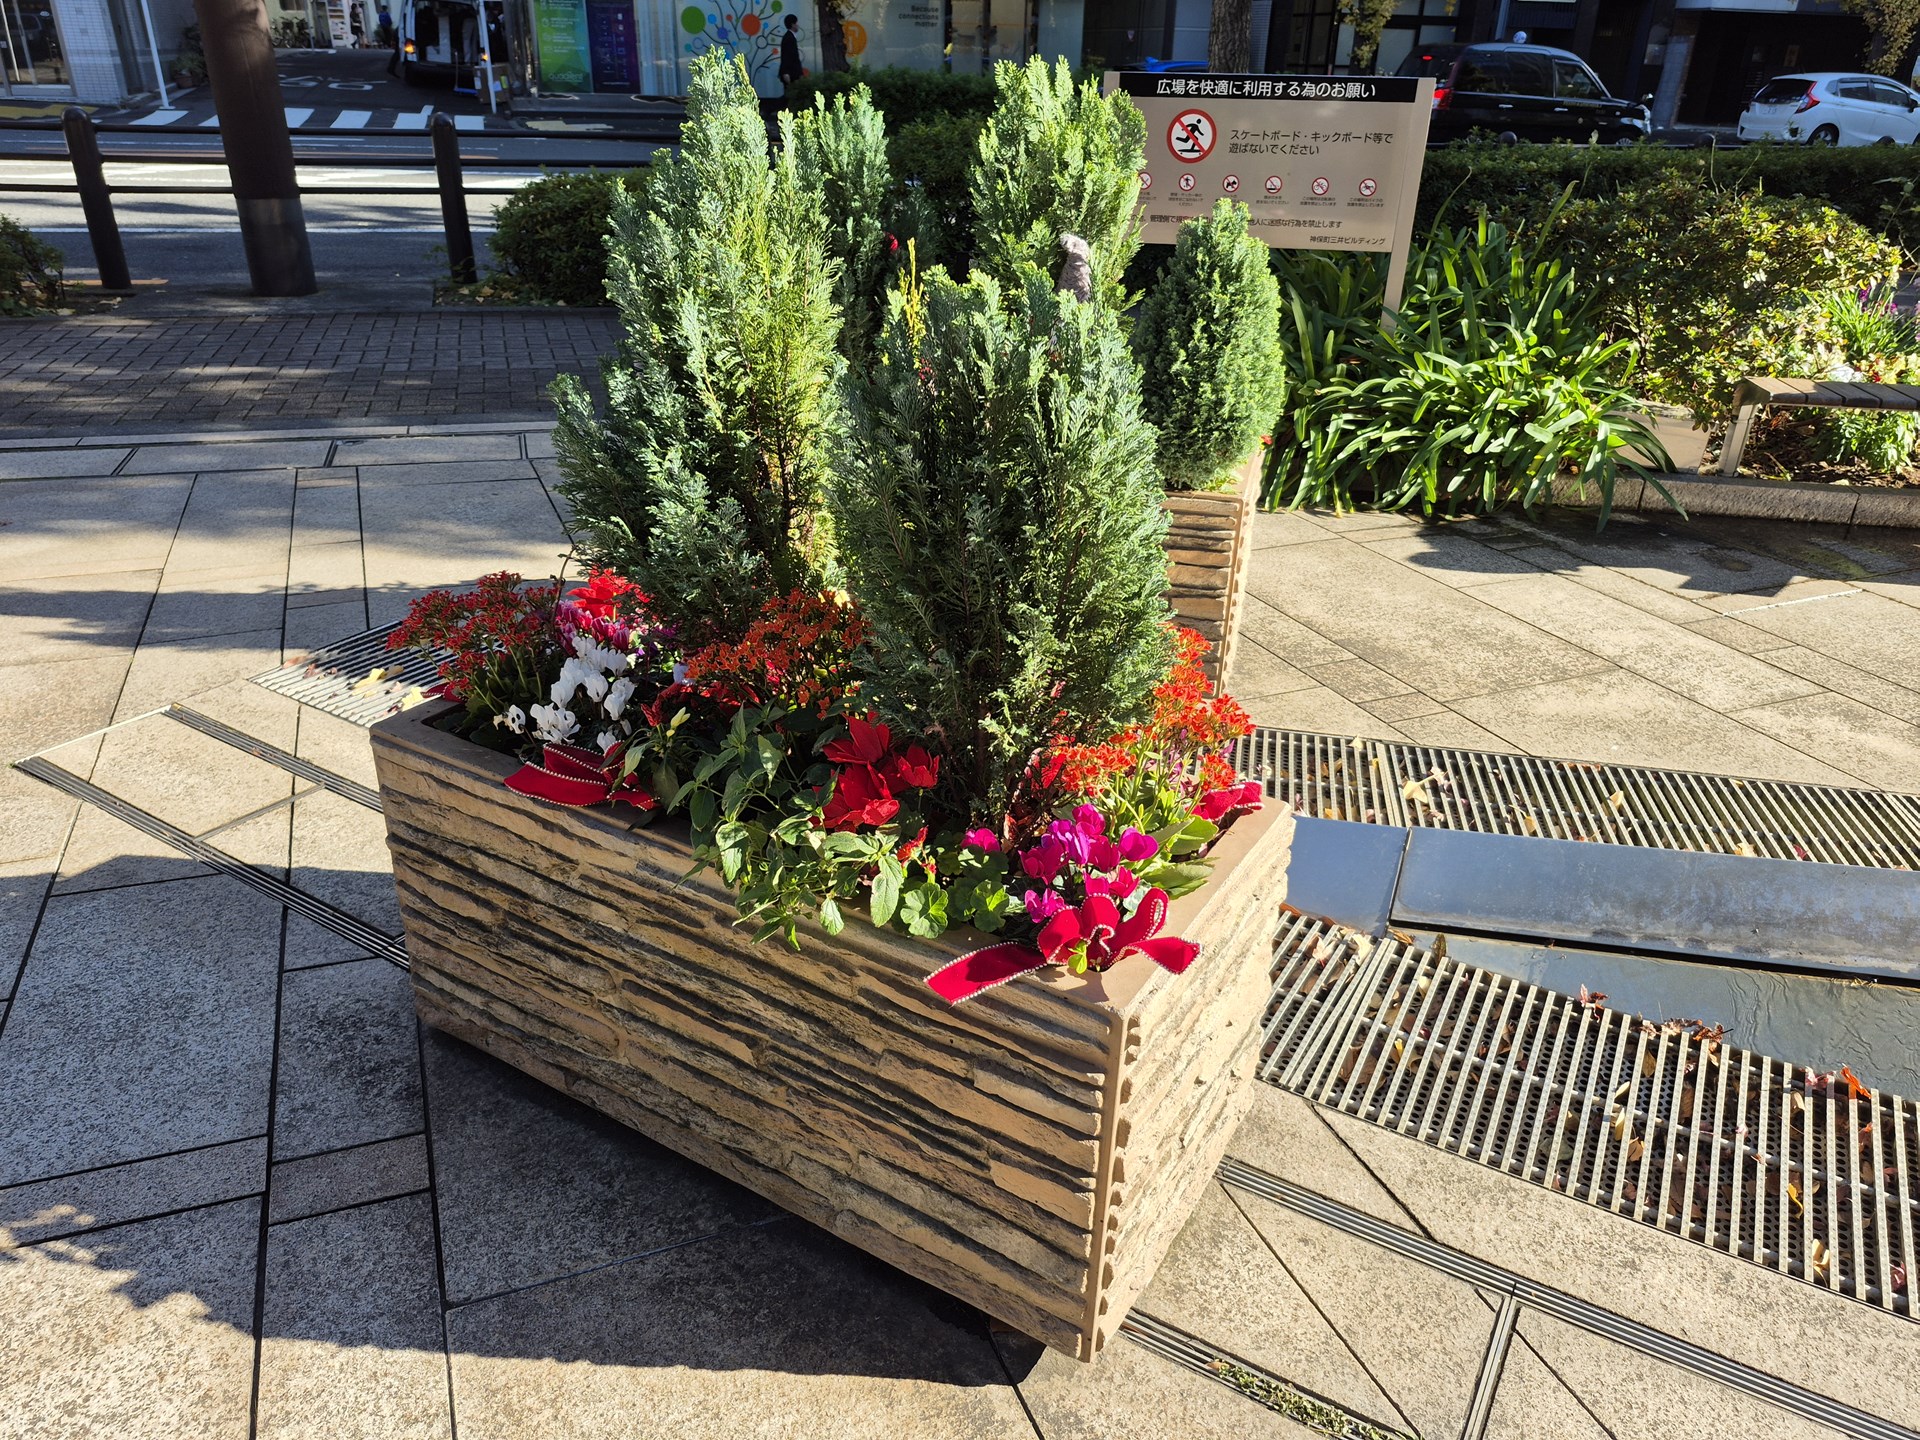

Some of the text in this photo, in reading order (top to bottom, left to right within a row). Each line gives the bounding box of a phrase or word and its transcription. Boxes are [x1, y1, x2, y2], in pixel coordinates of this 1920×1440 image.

[1156, 78, 1376, 99] 広場を快適に利用する為のお願い
[1230, 129, 1394, 144] スケートボード・キックボード等で
[1228, 142, 1320, 155] 遊ばないでください
[1309, 235, 1386, 246] 神保町三井ビルディング
